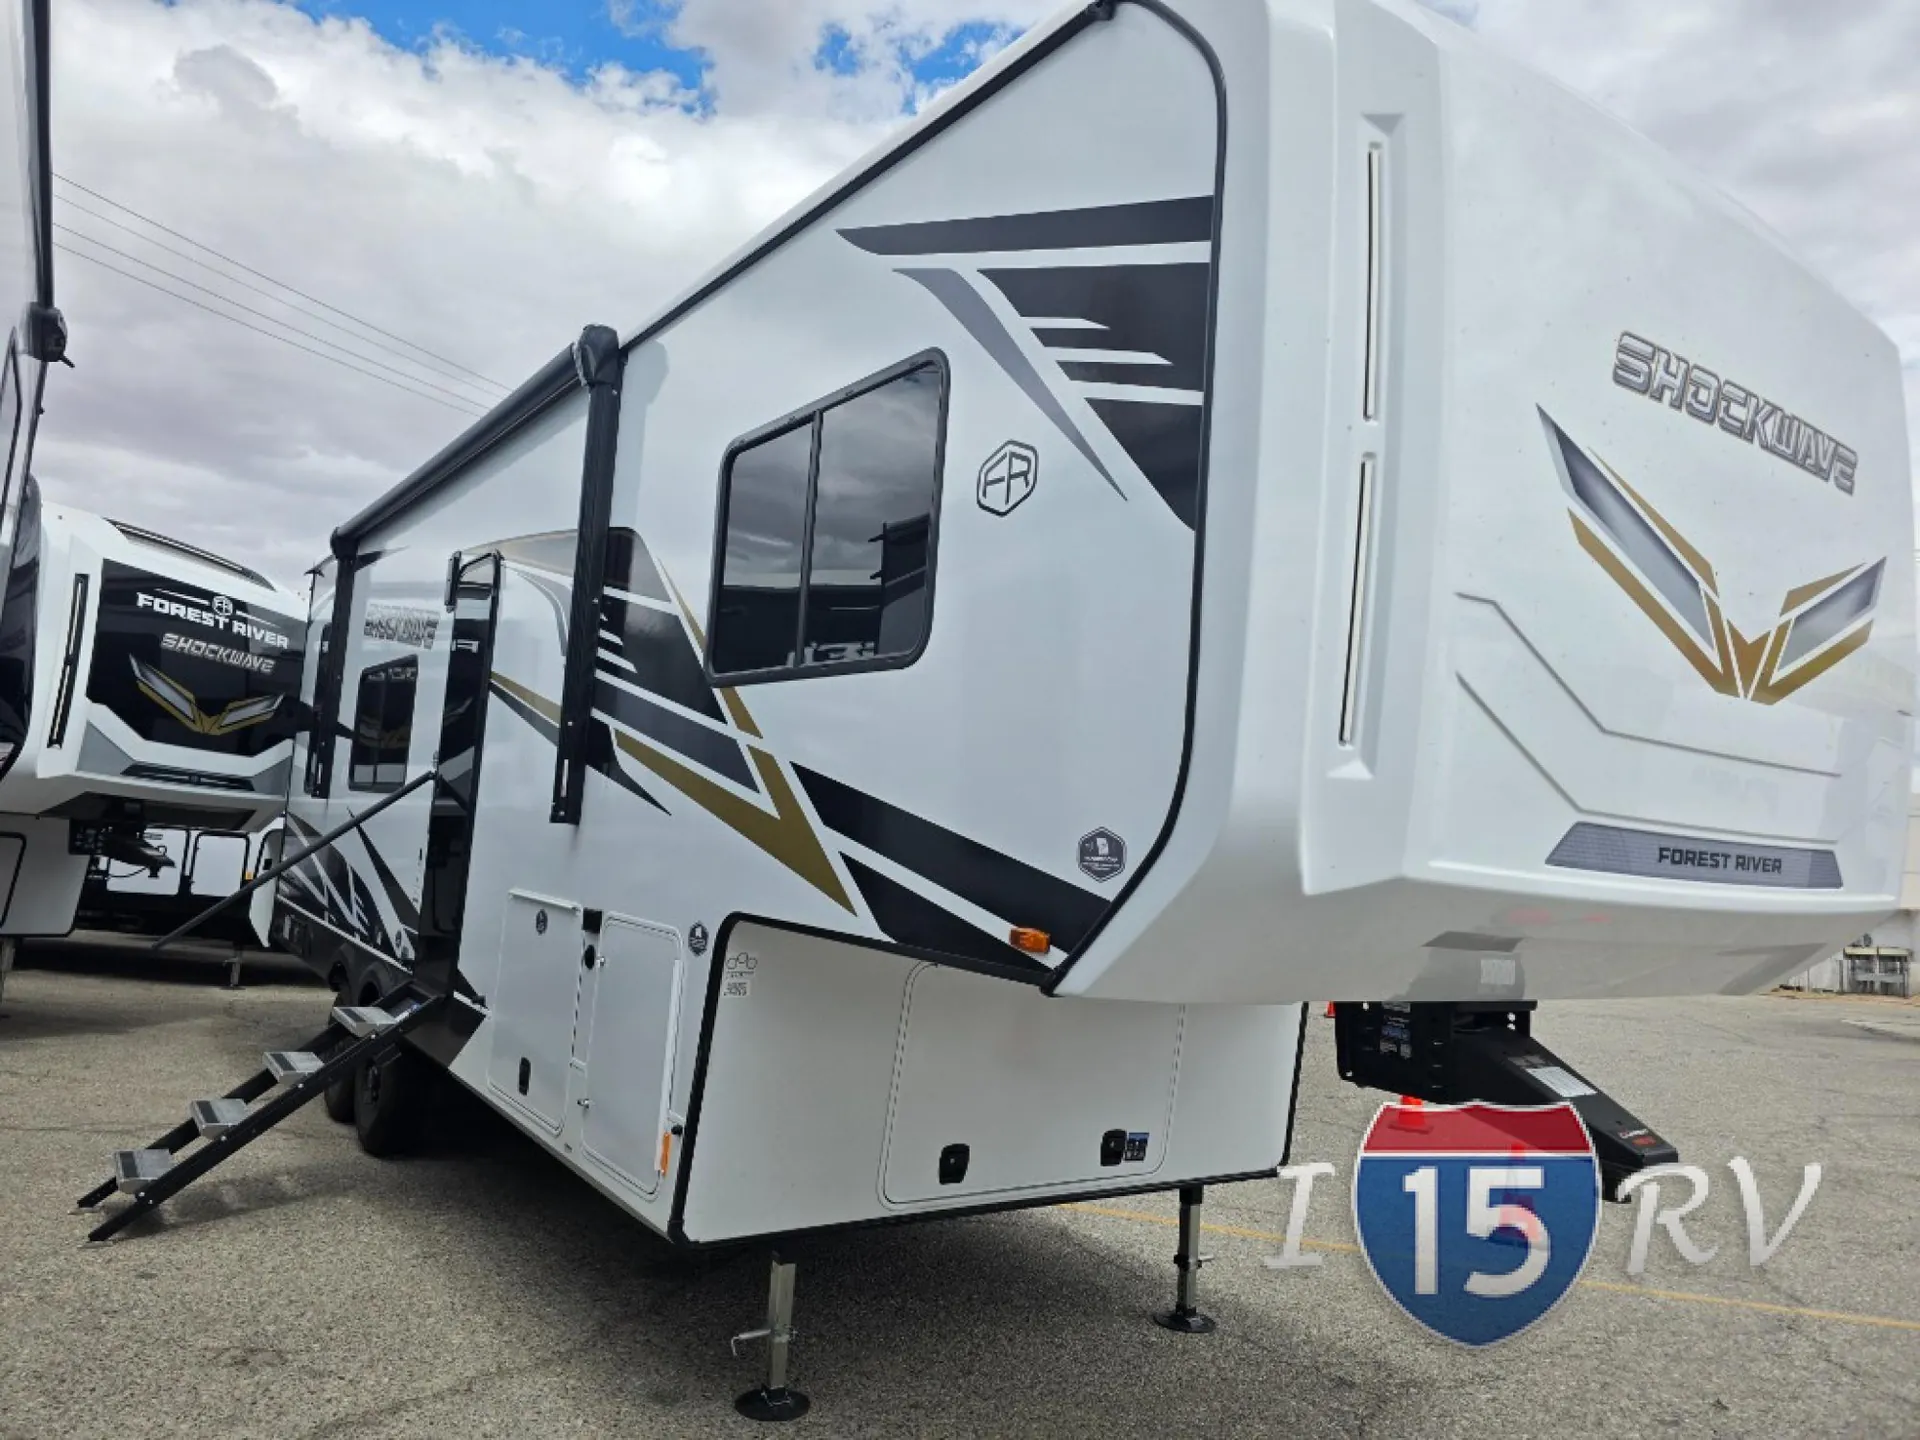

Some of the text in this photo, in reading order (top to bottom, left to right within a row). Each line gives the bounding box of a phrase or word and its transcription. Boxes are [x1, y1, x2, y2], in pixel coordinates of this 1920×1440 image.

[1612, 330, 1859, 497] SHOCKWAVE
[136, 592, 289, 649] FOREST RIVER
[161, 632, 276, 674] SHOCKWAVE
[1658, 847, 1782, 874] FOREST RIVER
